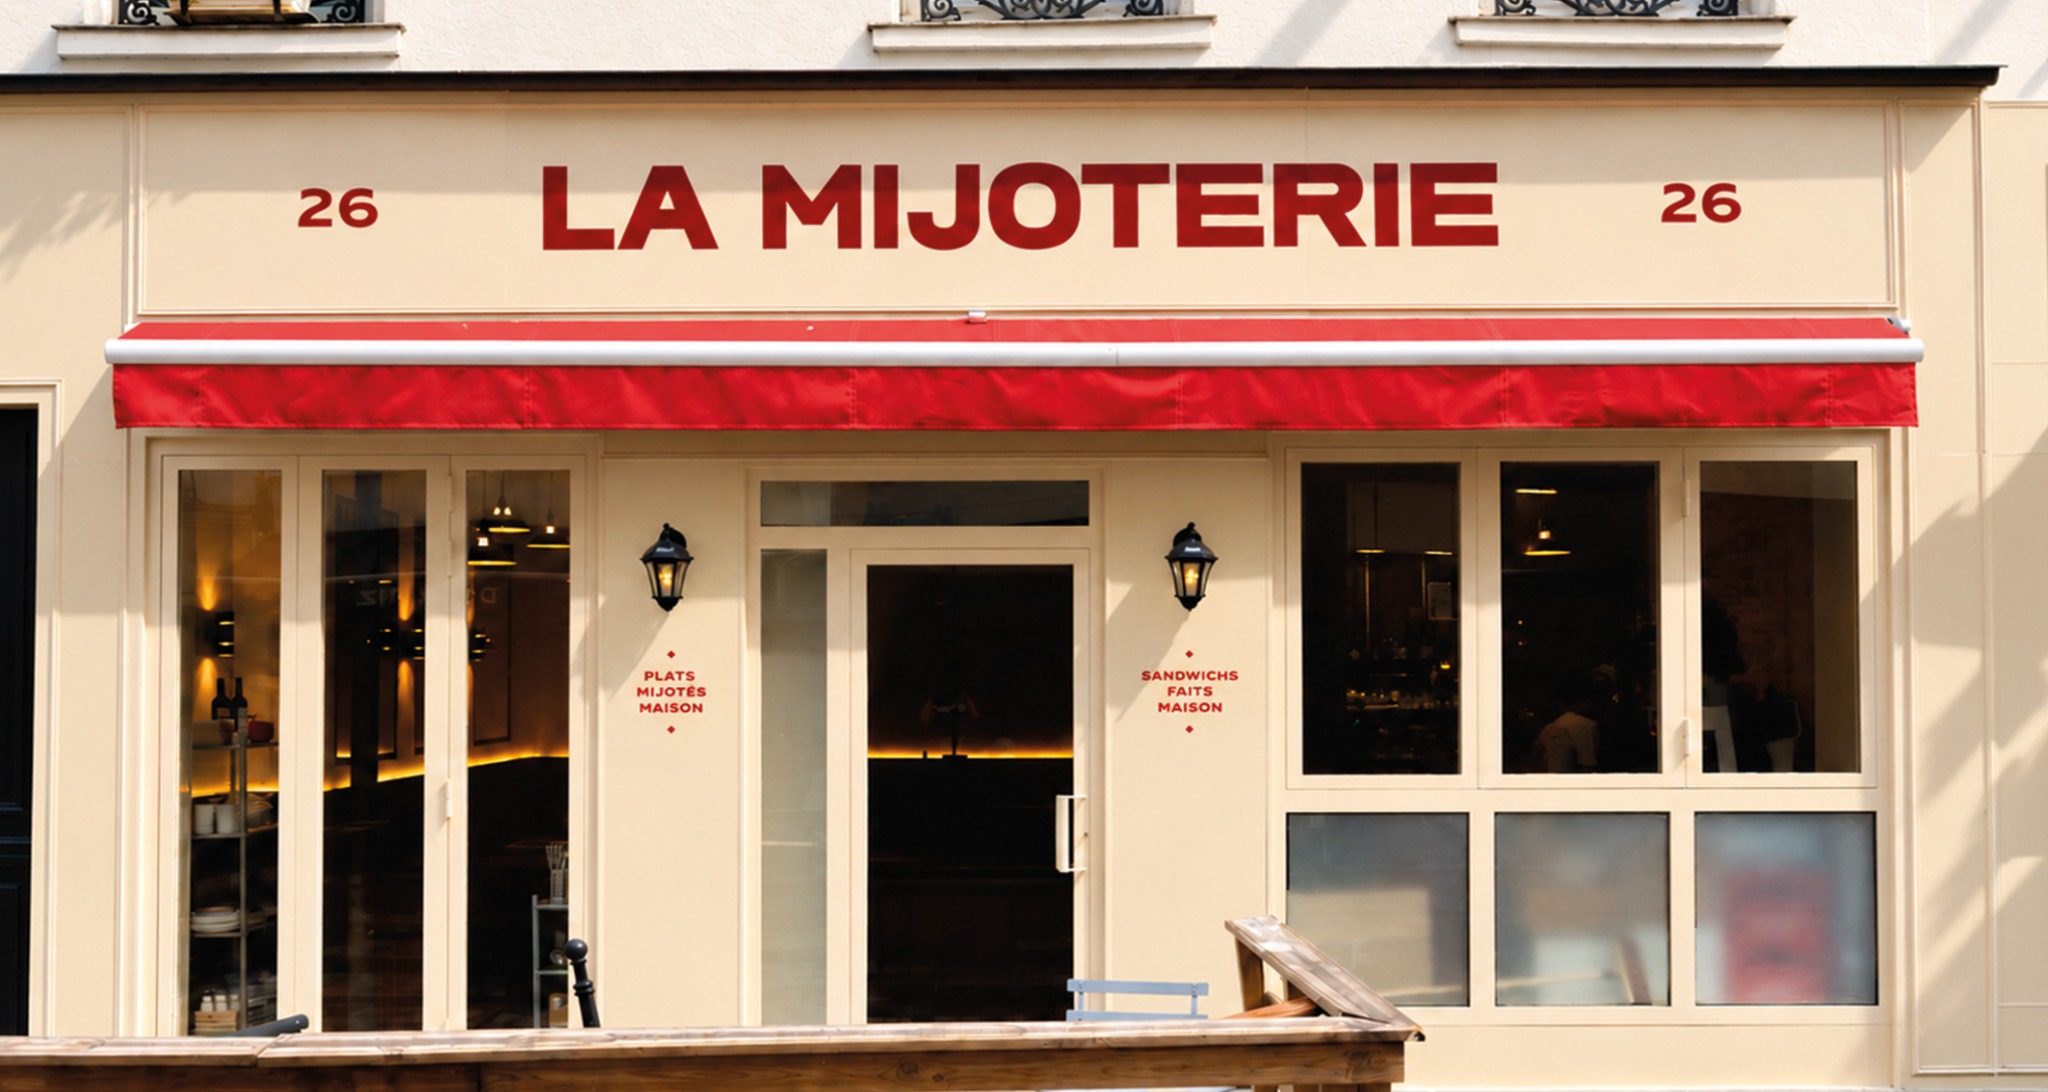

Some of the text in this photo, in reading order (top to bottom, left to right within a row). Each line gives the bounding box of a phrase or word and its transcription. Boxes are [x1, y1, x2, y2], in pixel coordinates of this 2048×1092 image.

[298, 188, 379, 228] 26
[543, 162, 1499, 250] LA MIJOTERIE
[1661, 183, 1742, 223] 26
[644, 670, 696, 682] PLATS
[1141, 670, 1239, 682] SANDWICHS
[636, 684, 707, 698] MIJOTÉS
[1167, 685, 1213, 697] FAITS
[639, 702, 704, 713] MAISON
[1158, 702, 1223, 713] MAISON
